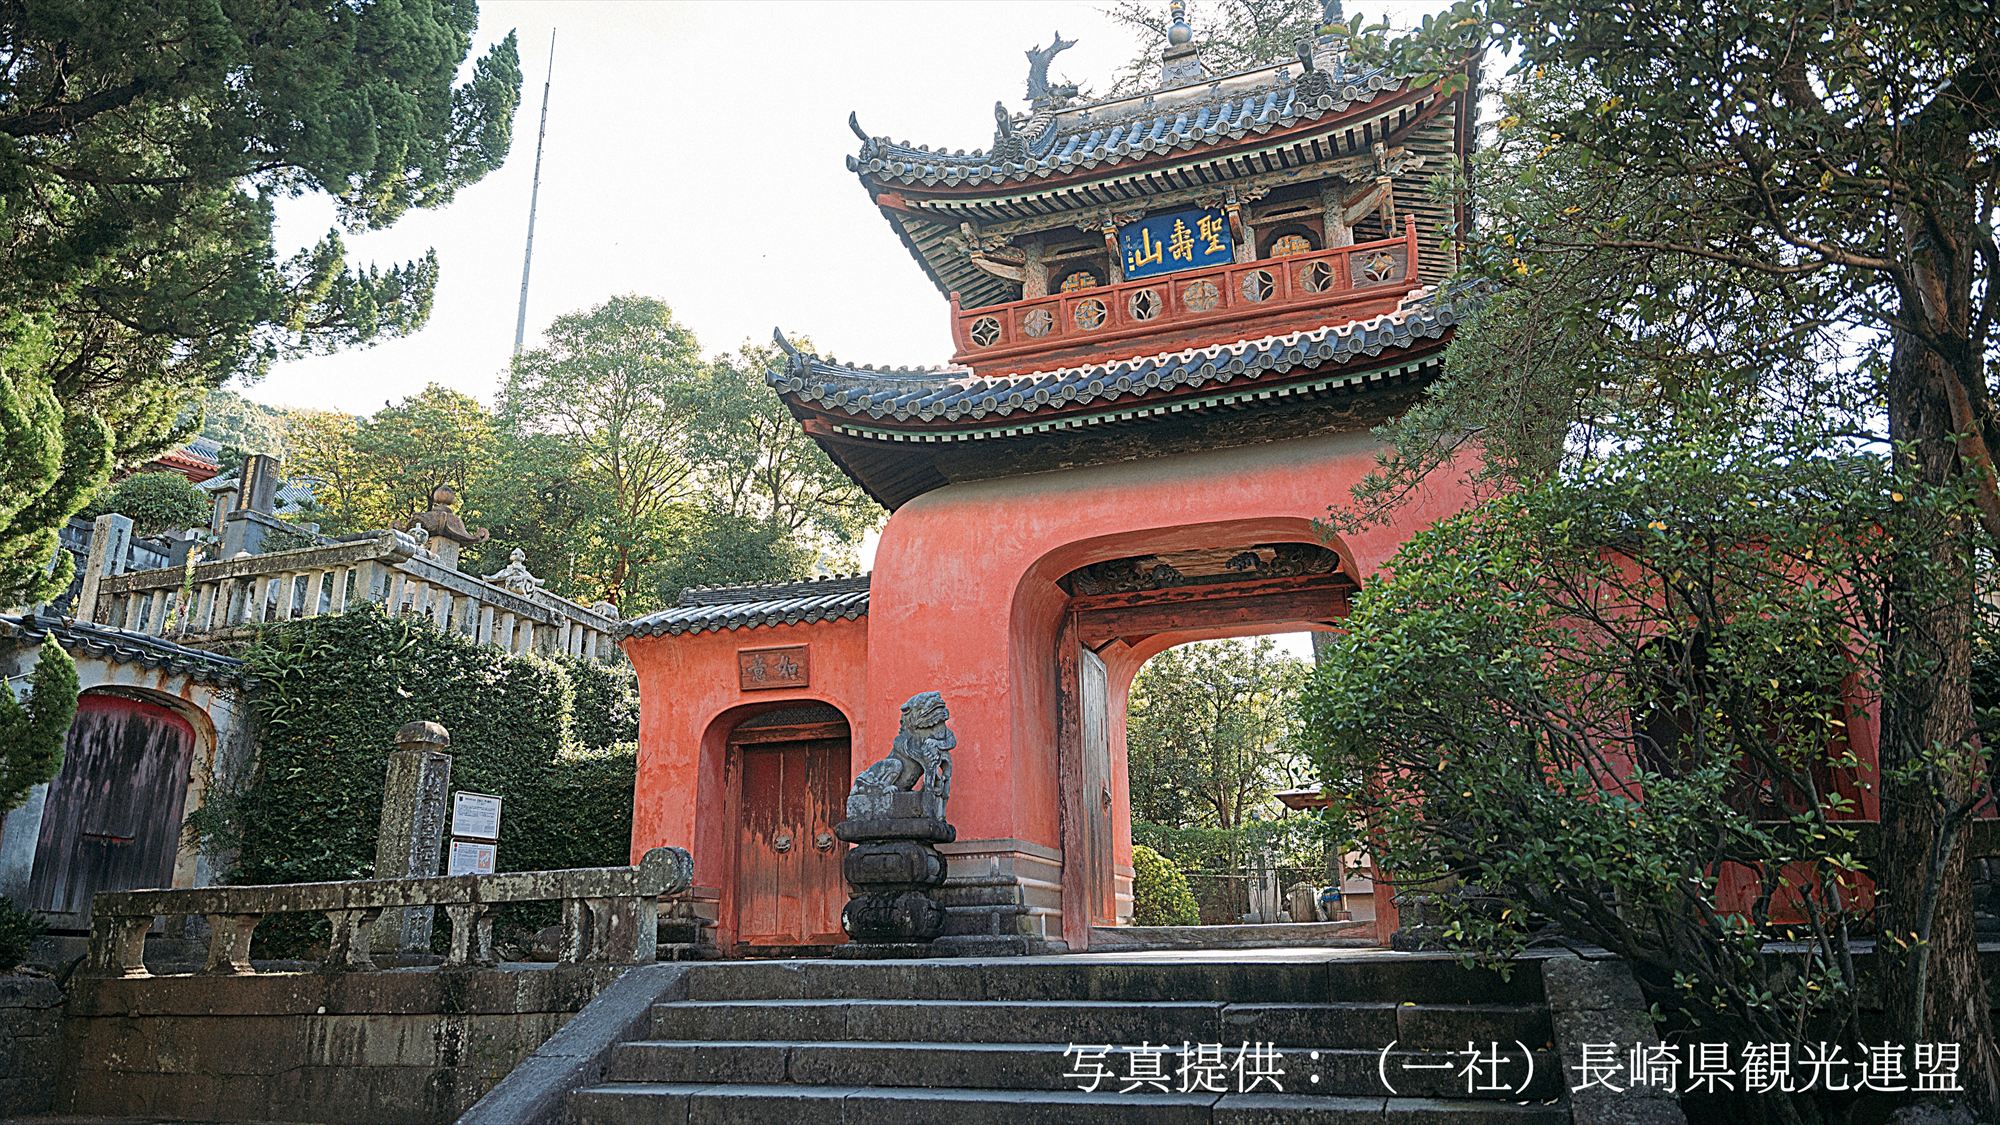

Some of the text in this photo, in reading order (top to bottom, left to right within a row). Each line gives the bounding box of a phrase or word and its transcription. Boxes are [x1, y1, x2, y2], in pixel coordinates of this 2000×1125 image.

[1135, 214, 1226, 267] 聖壽山
[747, 654, 799, 681] 如意
